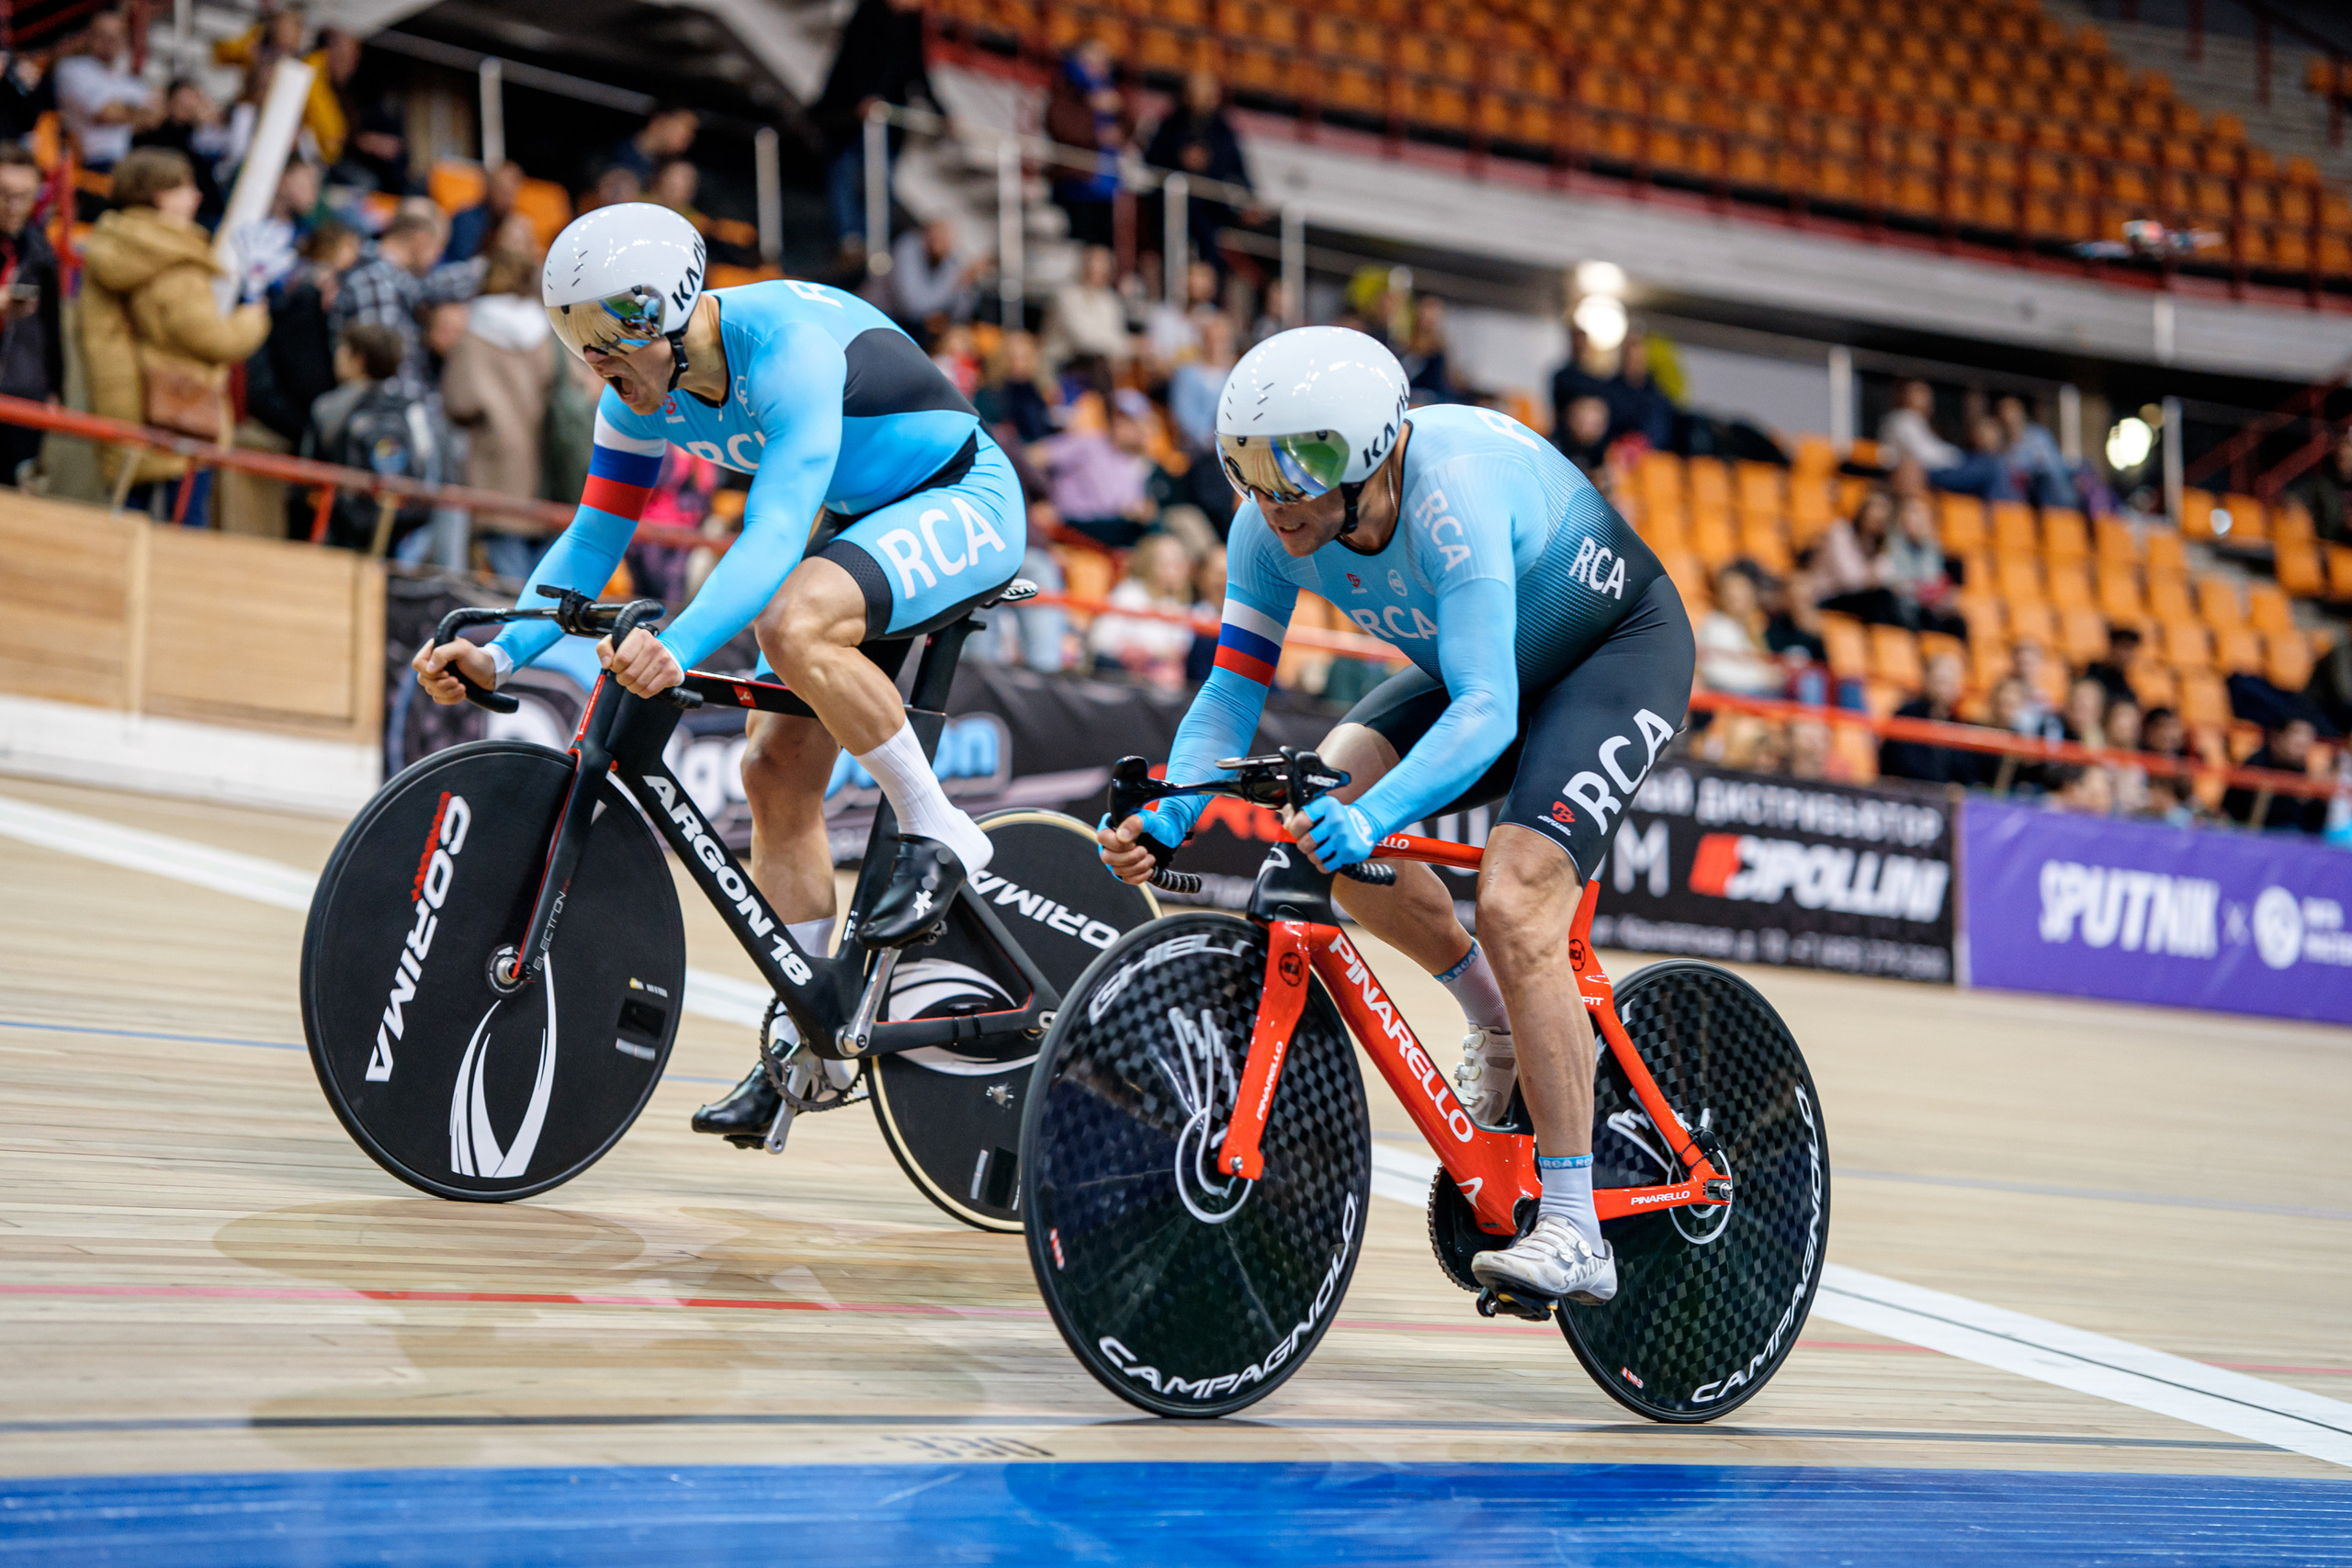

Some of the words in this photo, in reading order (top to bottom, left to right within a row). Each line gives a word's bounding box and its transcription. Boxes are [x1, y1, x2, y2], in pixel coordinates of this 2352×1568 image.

[876, 497, 1006, 600] RCA
[1416, 489, 1470, 571] RCA
[1568, 536, 1625, 600] RCA
[1350, 605, 1438, 639] RCA
[1562, 708, 1674, 836] RCA
[641, 775, 775, 938] ARGON
[770, 933, 813, 987] 18
[967, 870, 1121, 950] ORIMA
[366, 795, 471, 1082] CORIMA
[1257, 1041, 1283, 1121] PINARELLO
[1329, 933, 1474, 1143] PINARELLO
[1631, 1190, 1690, 1205] PINARELLO
[1691, 1086, 1820, 1404] CAMPAGNOLO
[1098, 1190, 1356, 1399] CAMPAGNOLO
